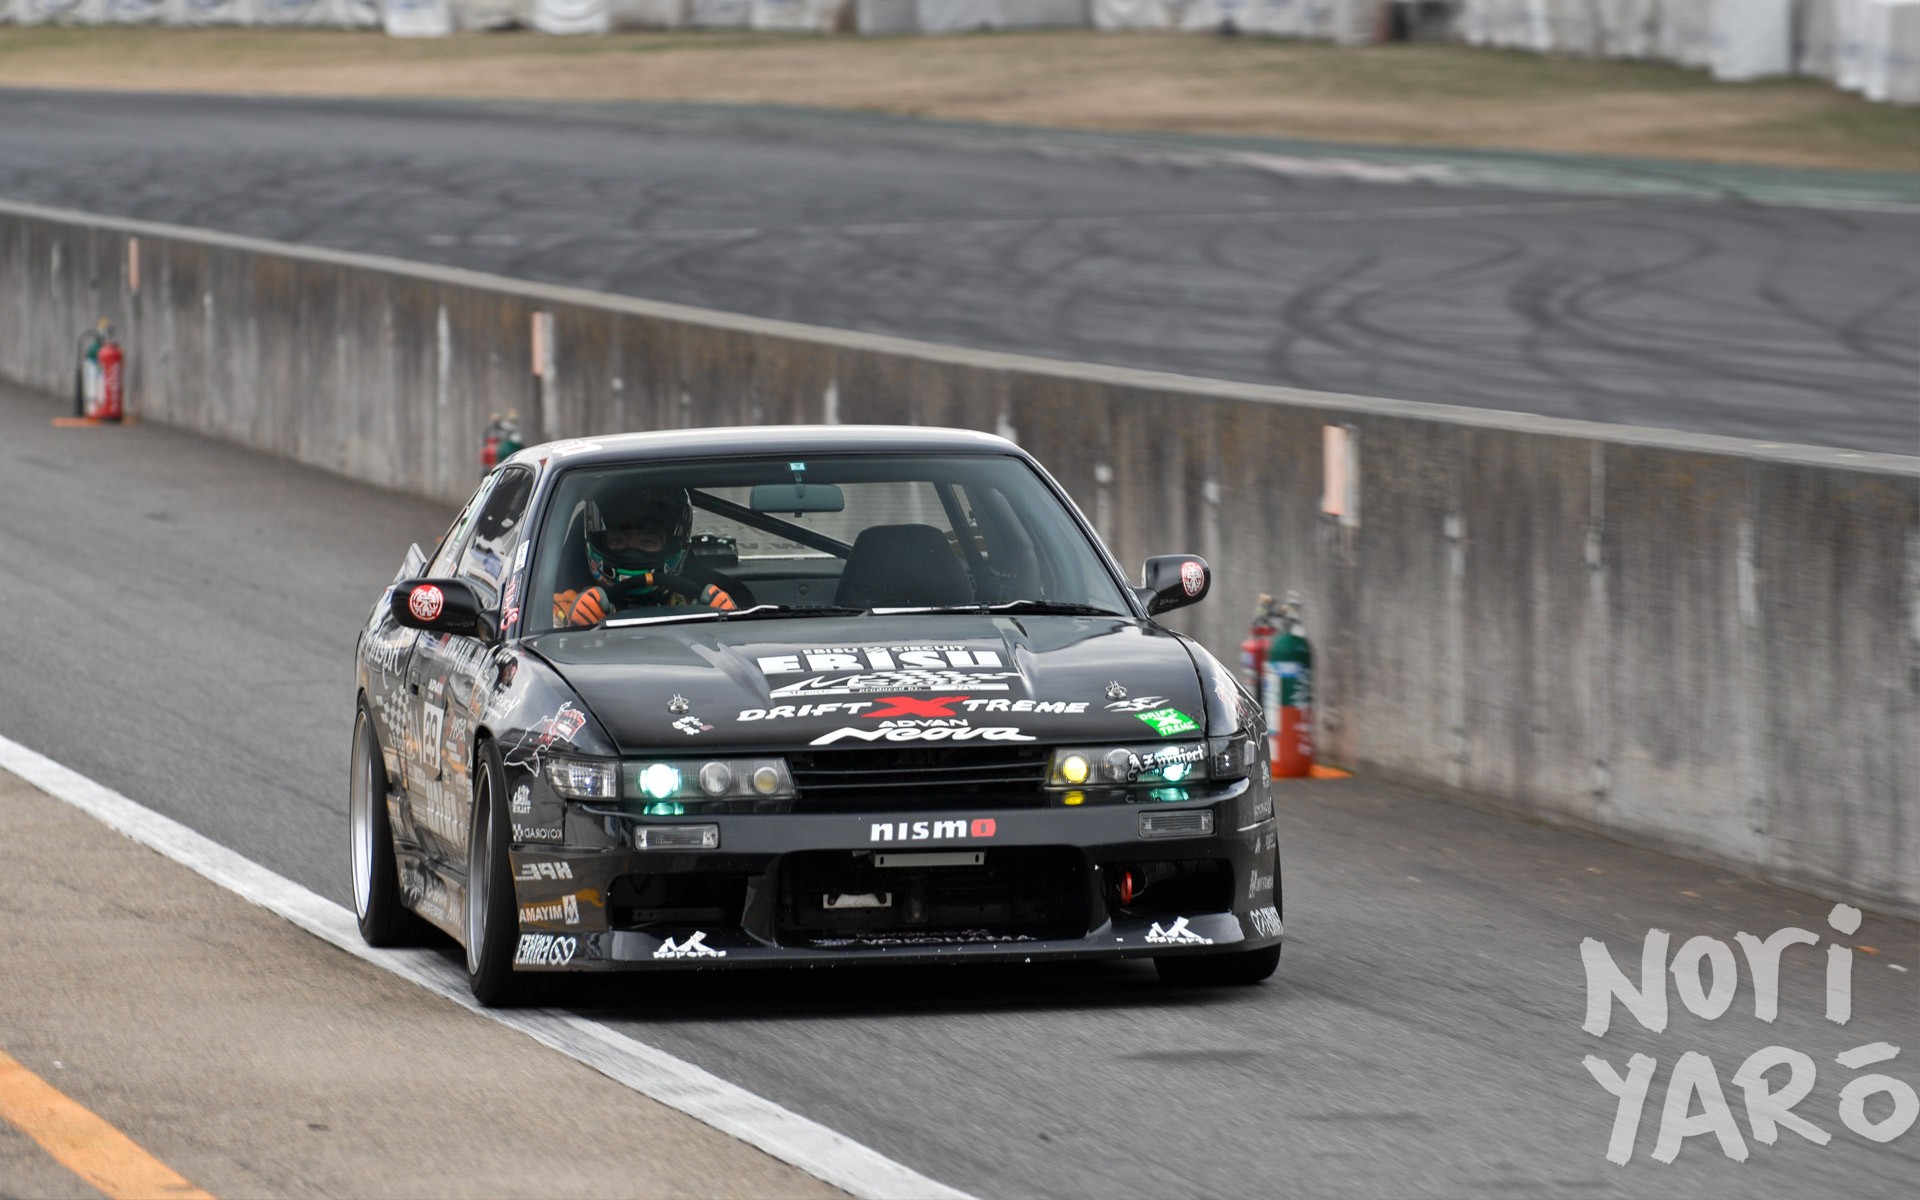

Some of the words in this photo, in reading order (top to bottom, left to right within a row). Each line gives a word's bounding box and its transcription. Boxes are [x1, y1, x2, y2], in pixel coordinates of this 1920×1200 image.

[737, 701, 873, 721] DRIFT
[963, 699, 1090, 714] TREME
[1138, 708, 1179, 722] DRIFT
[879, 719, 968, 728] ADVAN
[1158, 719, 1198, 735] TREME
[870, 818, 997, 841] nismo
